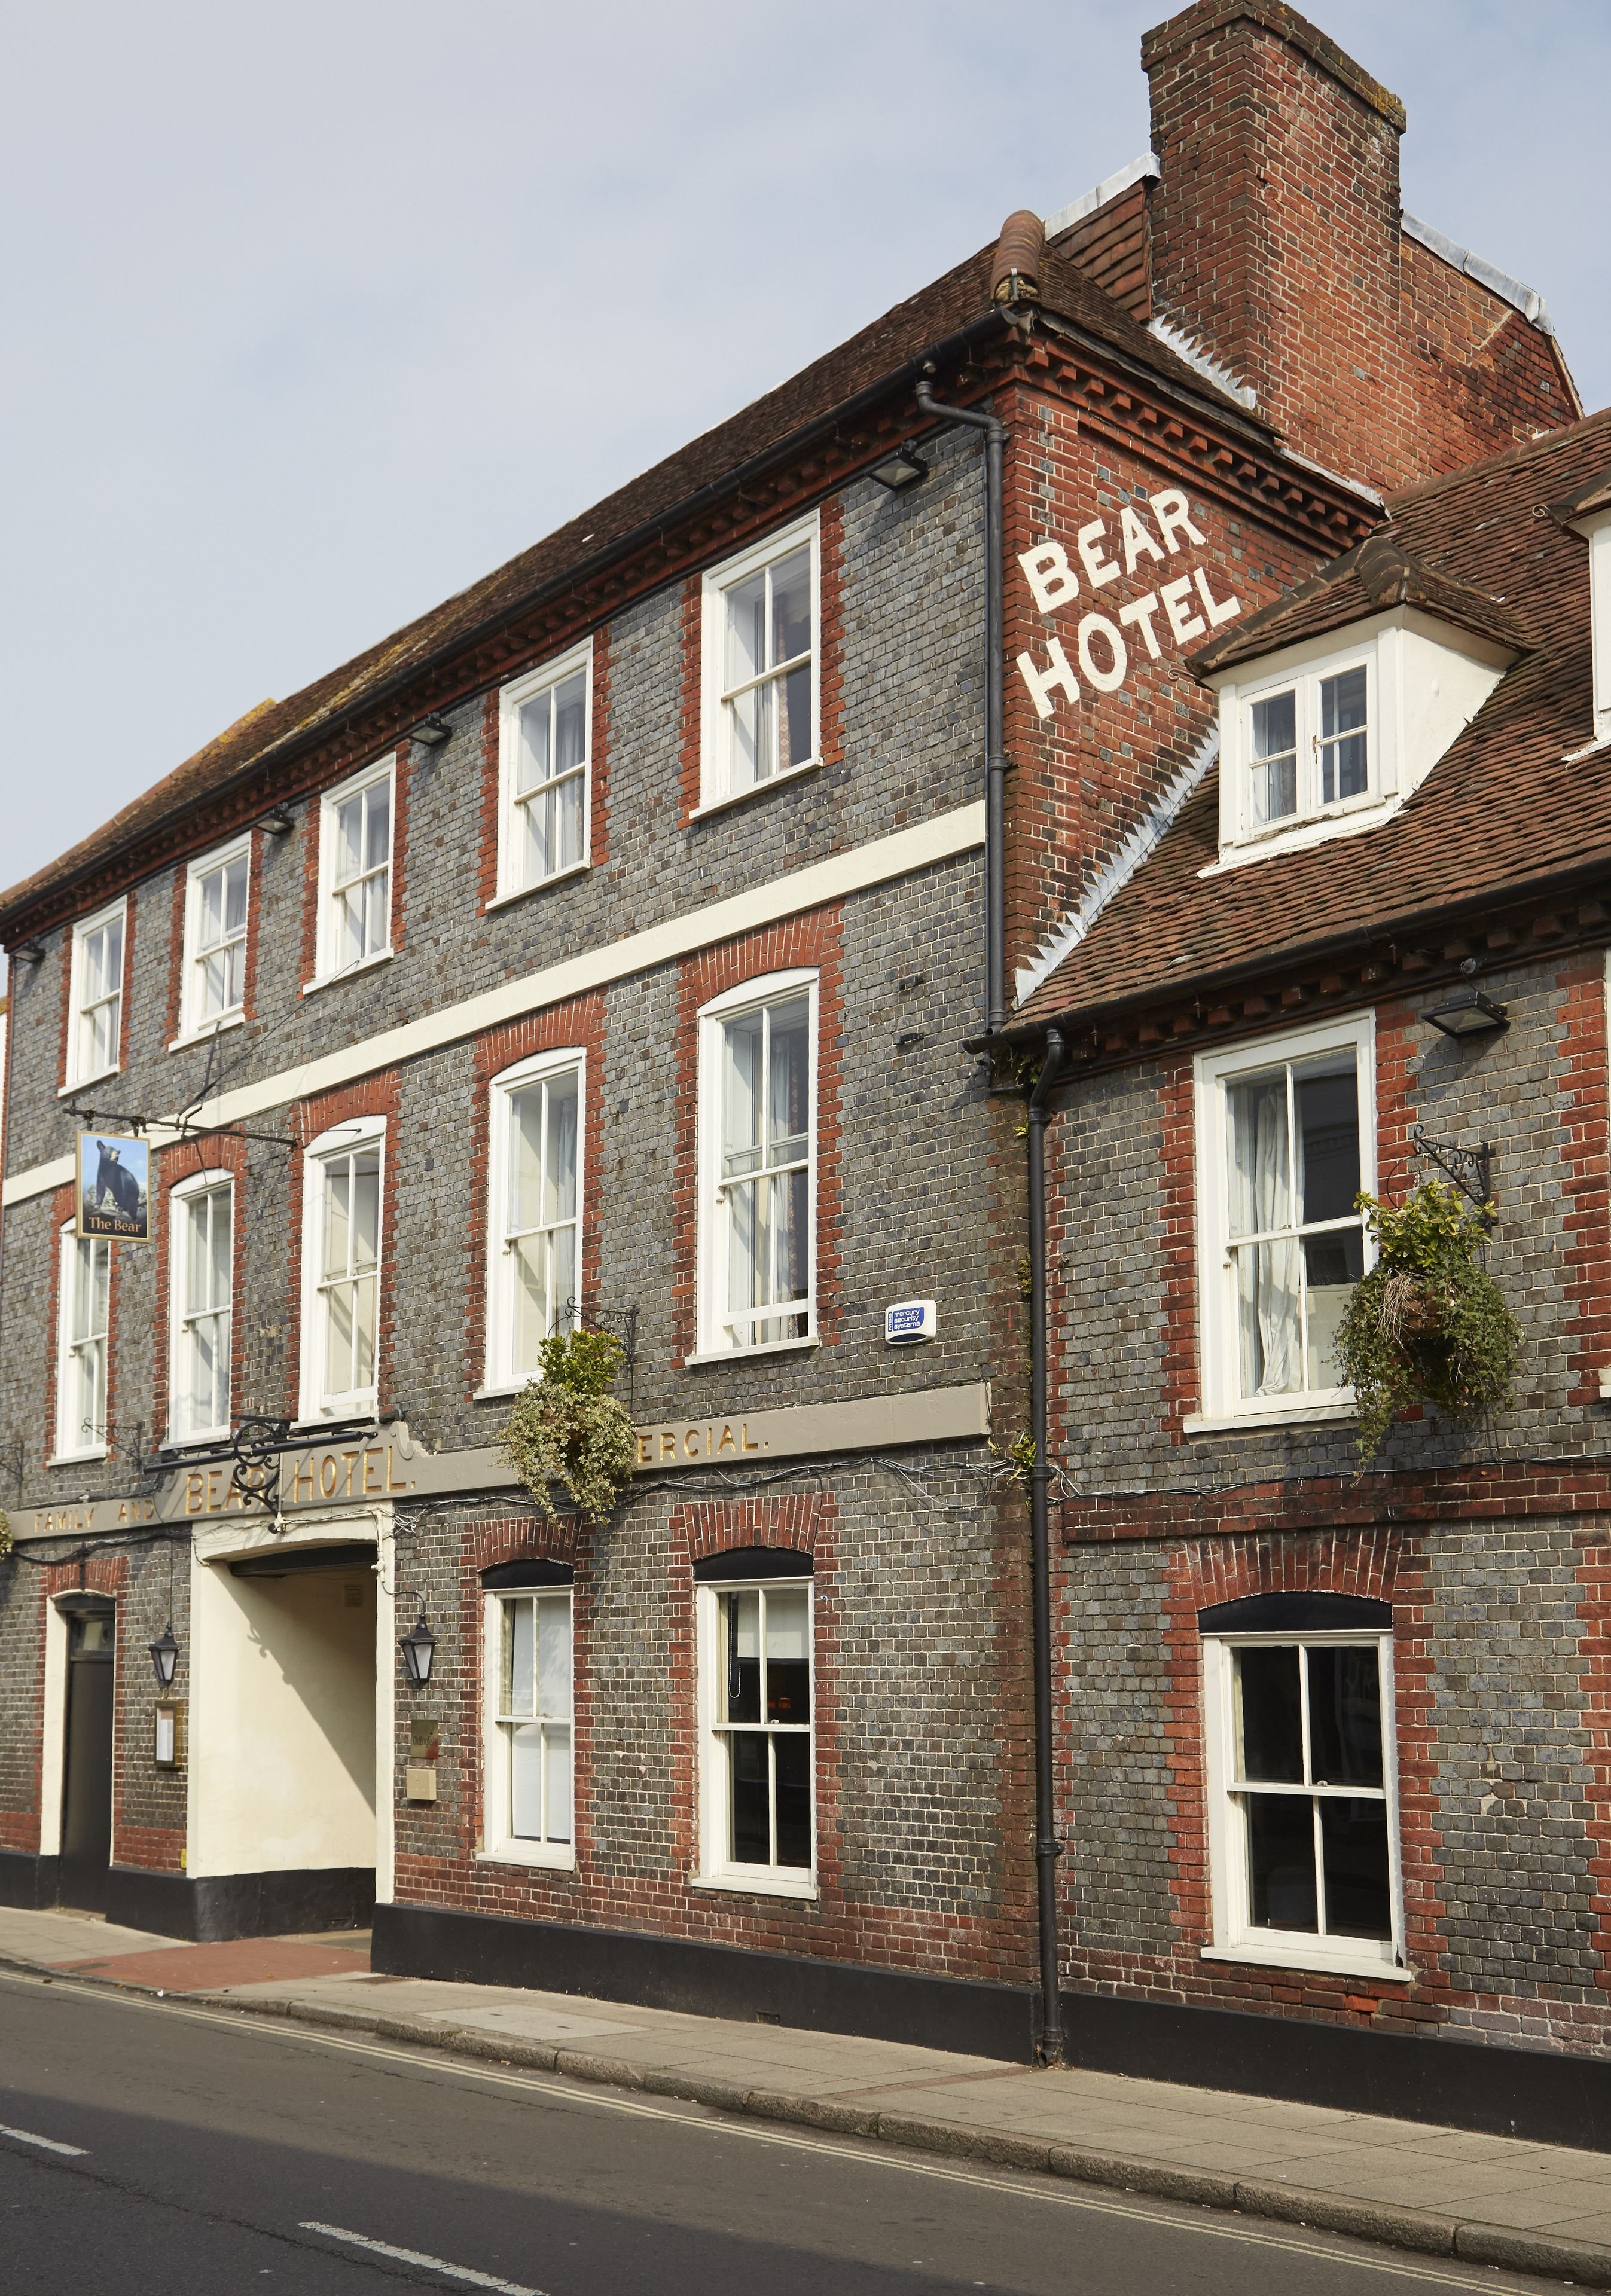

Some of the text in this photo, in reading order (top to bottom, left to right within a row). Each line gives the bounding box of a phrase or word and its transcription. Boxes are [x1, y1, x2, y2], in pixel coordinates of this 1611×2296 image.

[1018, 489, 1206, 613] BEAR
[1017, 567, 1241, 718] HOTEL
[89, 1217, 141, 1232] The Bear
[894, 1315, 919, 1324] security
[894, 1321, 920, 1330] systems
[34, 1500, 154, 1533] FAMILY AND
